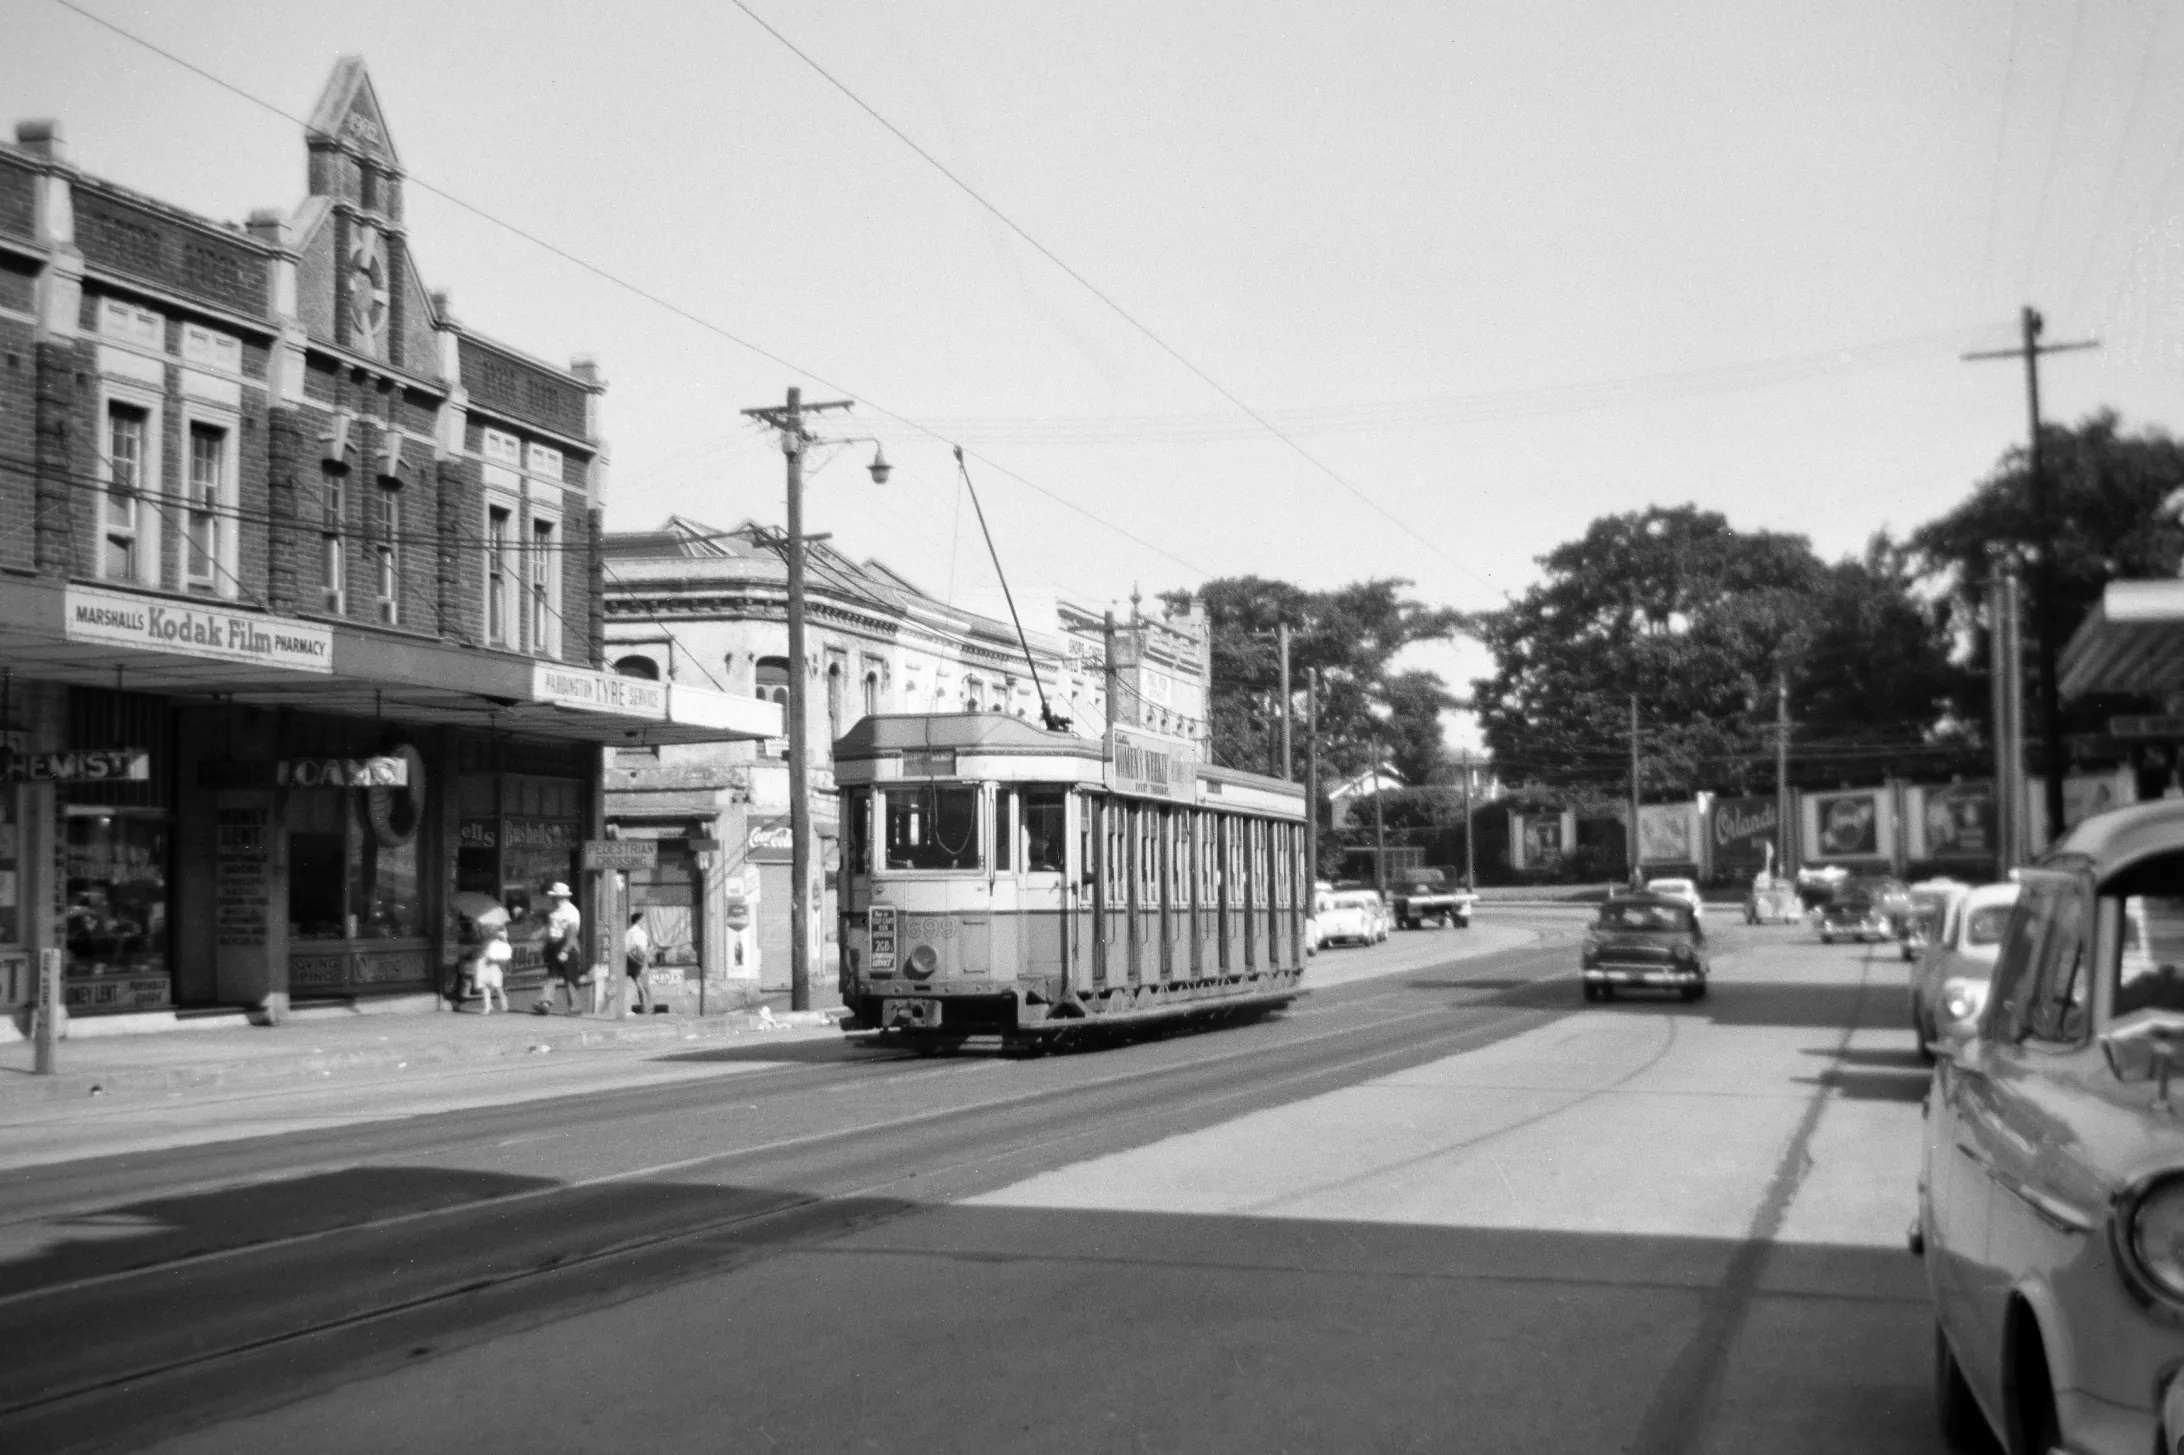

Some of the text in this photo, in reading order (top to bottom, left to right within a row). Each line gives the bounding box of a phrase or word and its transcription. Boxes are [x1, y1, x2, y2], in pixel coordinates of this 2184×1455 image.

[76, 606, 325, 656] MARSHALL'S Kodak Film PHARMACY
[595, 677, 625, 708] TYRE
[628, 686, 659, 709] SERVICE
[0, 751, 130, 781] HEMIST
[504, 818, 553, 849] Bushells
[587, 843, 655, 855] PEDESTRIAN
[595, 856, 647, 867] CROSSING
[906, 918, 957, 939] 699
[290, 957, 340, 970] OVING
